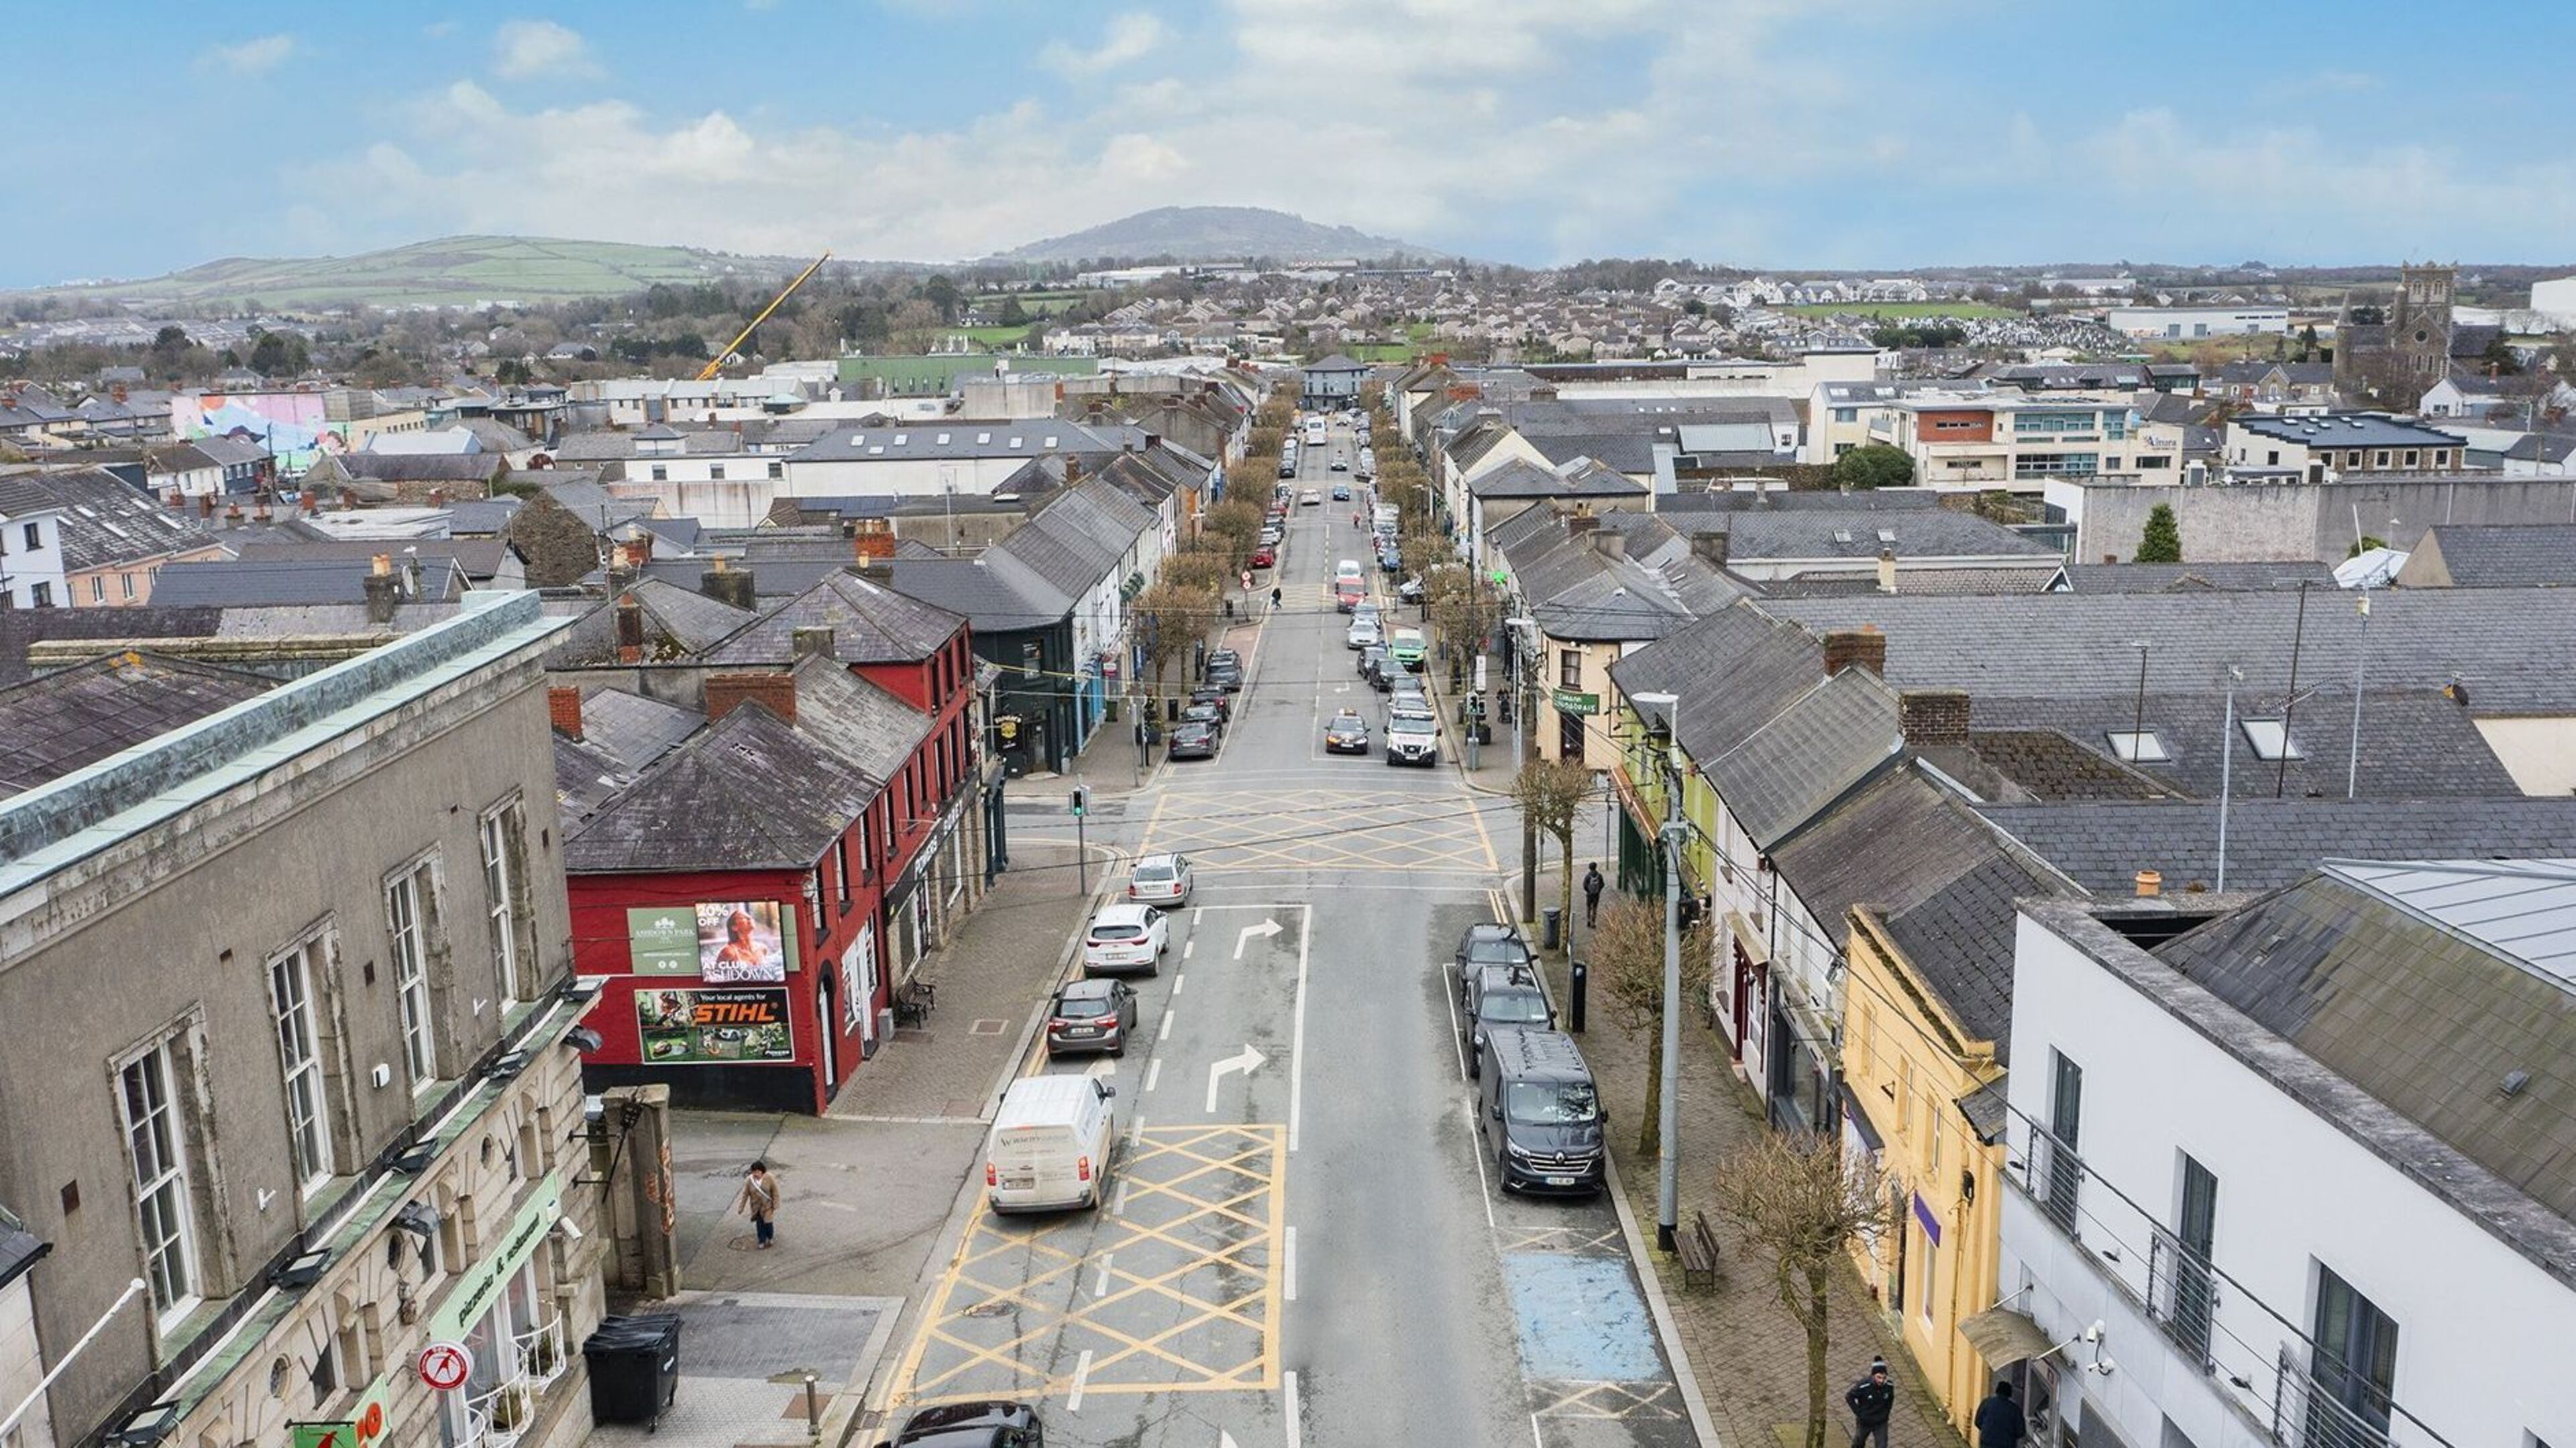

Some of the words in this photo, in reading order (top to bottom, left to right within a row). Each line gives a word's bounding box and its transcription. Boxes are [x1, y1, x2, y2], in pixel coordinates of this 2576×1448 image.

[696, 904, 729, 917] 20%
[698, 917, 719, 927] OFF
[702, 960, 716, 970] AT
[718, 960, 747, 970] CLUB
[703, 967, 775, 982] ASHDOWN
[734, 993, 755, 1002] agents
[694, 1003, 775, 1022] STIHL
[459, 1274, 494, 1328] pizzeria
[496, 1256, 504, 1276] &
[507, 1212, 539, 1261] restaurant
